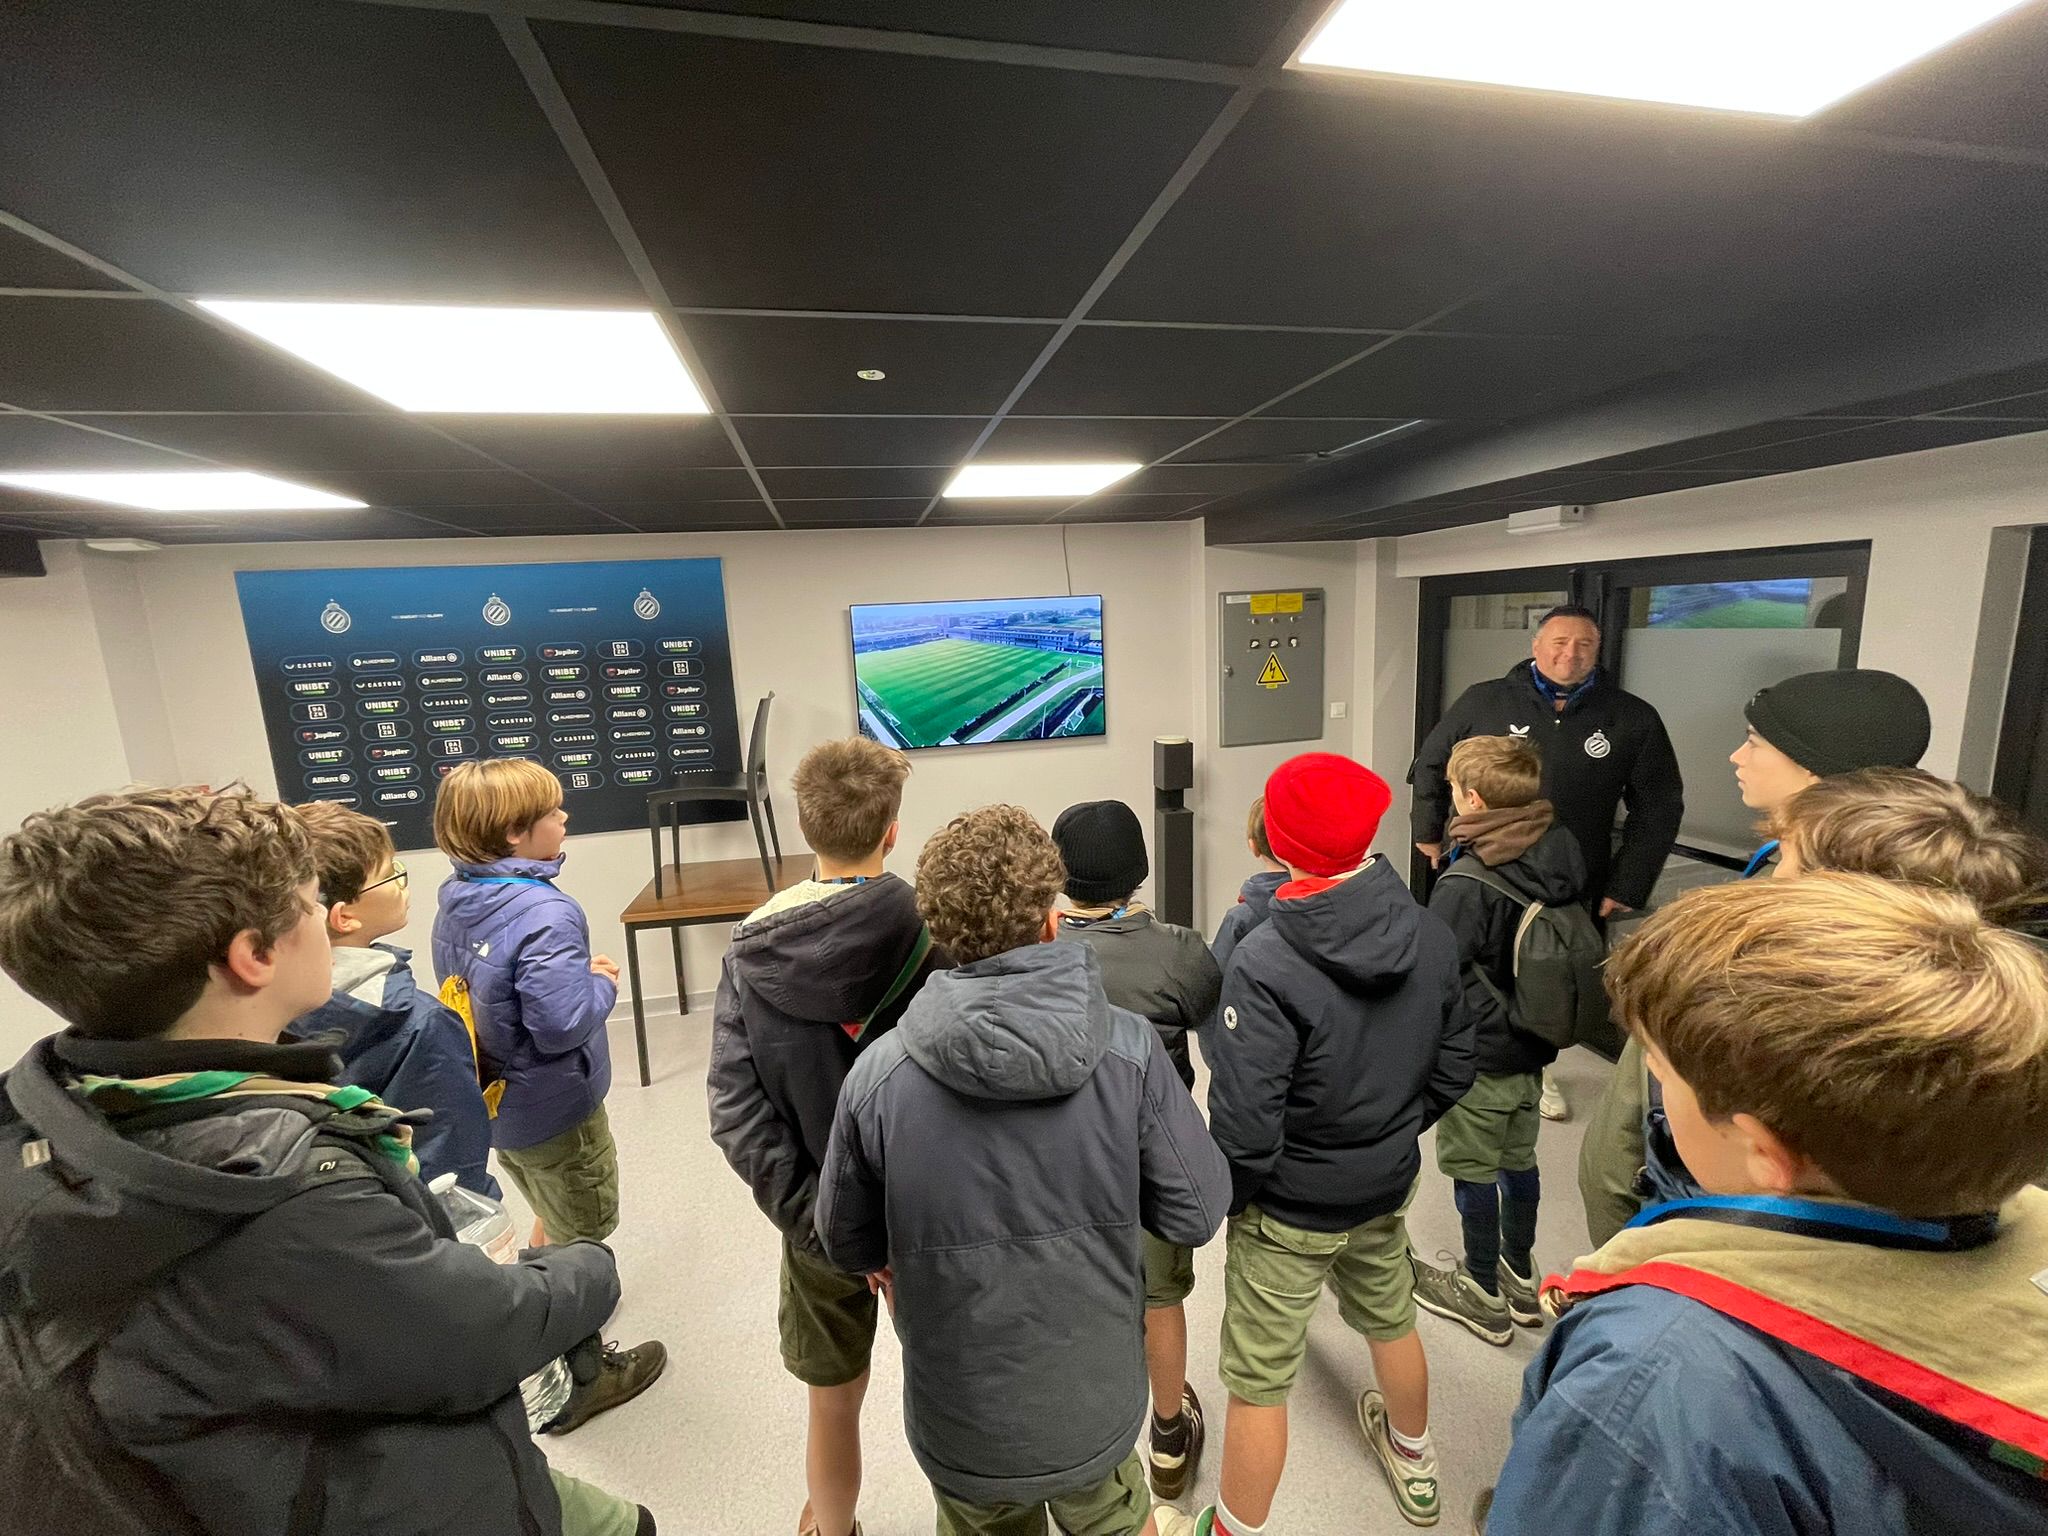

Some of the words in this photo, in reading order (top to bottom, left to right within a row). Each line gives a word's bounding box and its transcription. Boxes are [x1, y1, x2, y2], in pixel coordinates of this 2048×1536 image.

[484, 649, 516, 657] UNIBET
[549, 668, 580, 676] UNIBET
[295, 682, 329, 691] UNIBET
[611, 686, 641, 694] UNIBET
[365, 701, 399, 709] UNIBET
[433, 719, 465, 727] UNIBET
[498, 736, 530, 744] UNIBET
[309, 750, 342, 759] UNIBET
[562, 754, 592, 762] UNIBET
[378, 767, 410, 776] UNIBET
[623, 770, 652, 778] UNIBET
